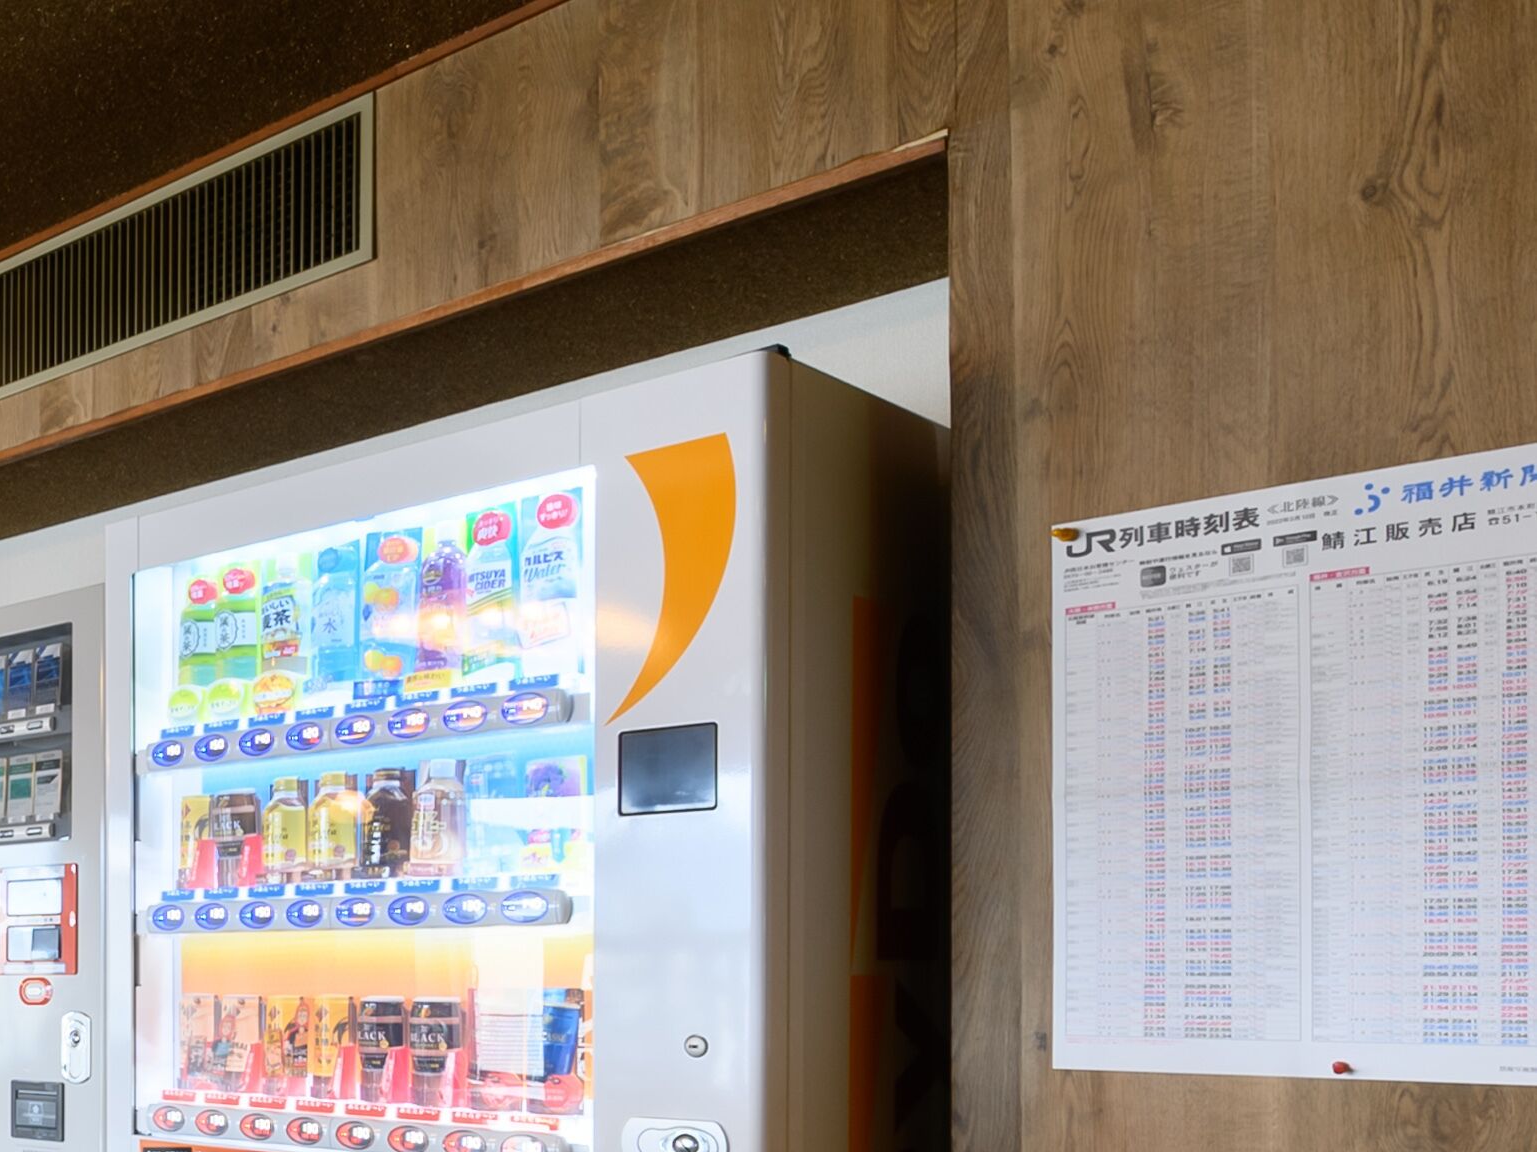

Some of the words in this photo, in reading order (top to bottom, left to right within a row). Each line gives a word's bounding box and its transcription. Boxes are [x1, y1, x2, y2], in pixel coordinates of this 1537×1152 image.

[1066, 507, 1260, 558] JR列車時刻表
[1321, 512, 1476, 550] 鯖江販売店
[358, 1031, 386, 1042] LACK
